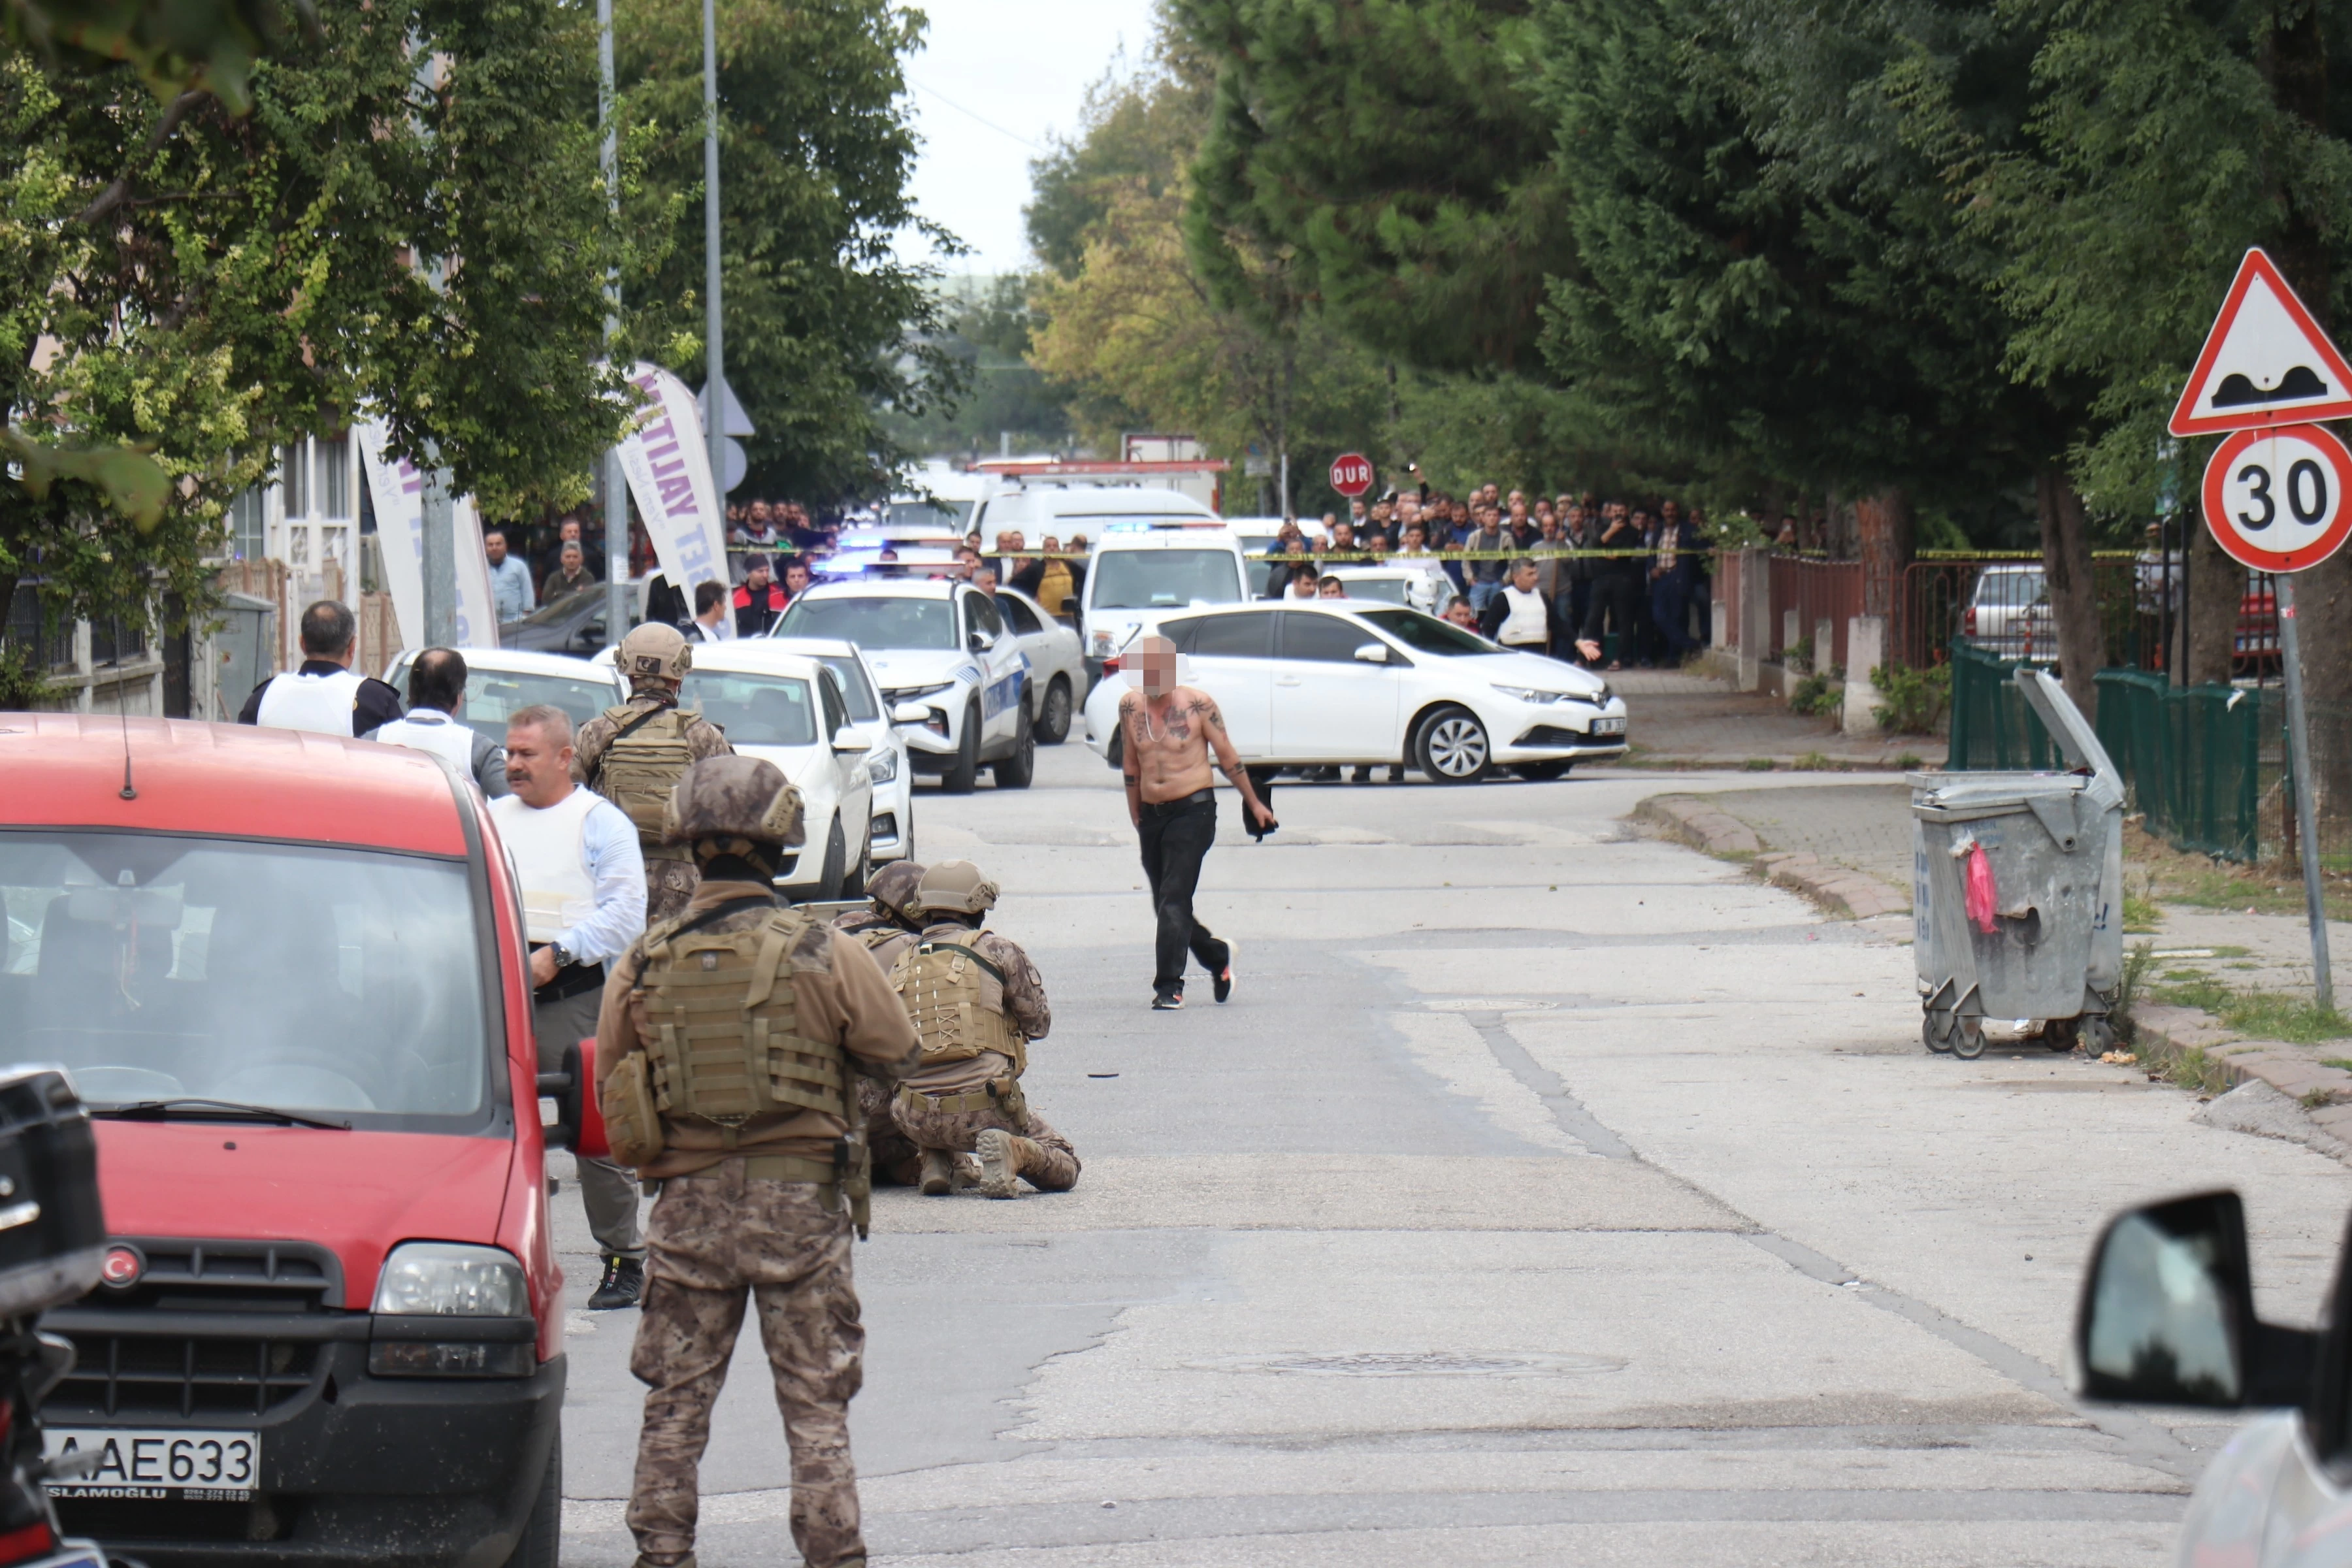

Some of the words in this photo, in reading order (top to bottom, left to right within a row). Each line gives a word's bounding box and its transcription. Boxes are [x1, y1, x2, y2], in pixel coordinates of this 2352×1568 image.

[1333, 464, 1369, 485] DUR
[2237, 459, 2327, 531] 30
[43, 1486, 167, 1499] SLAMOĞLU
